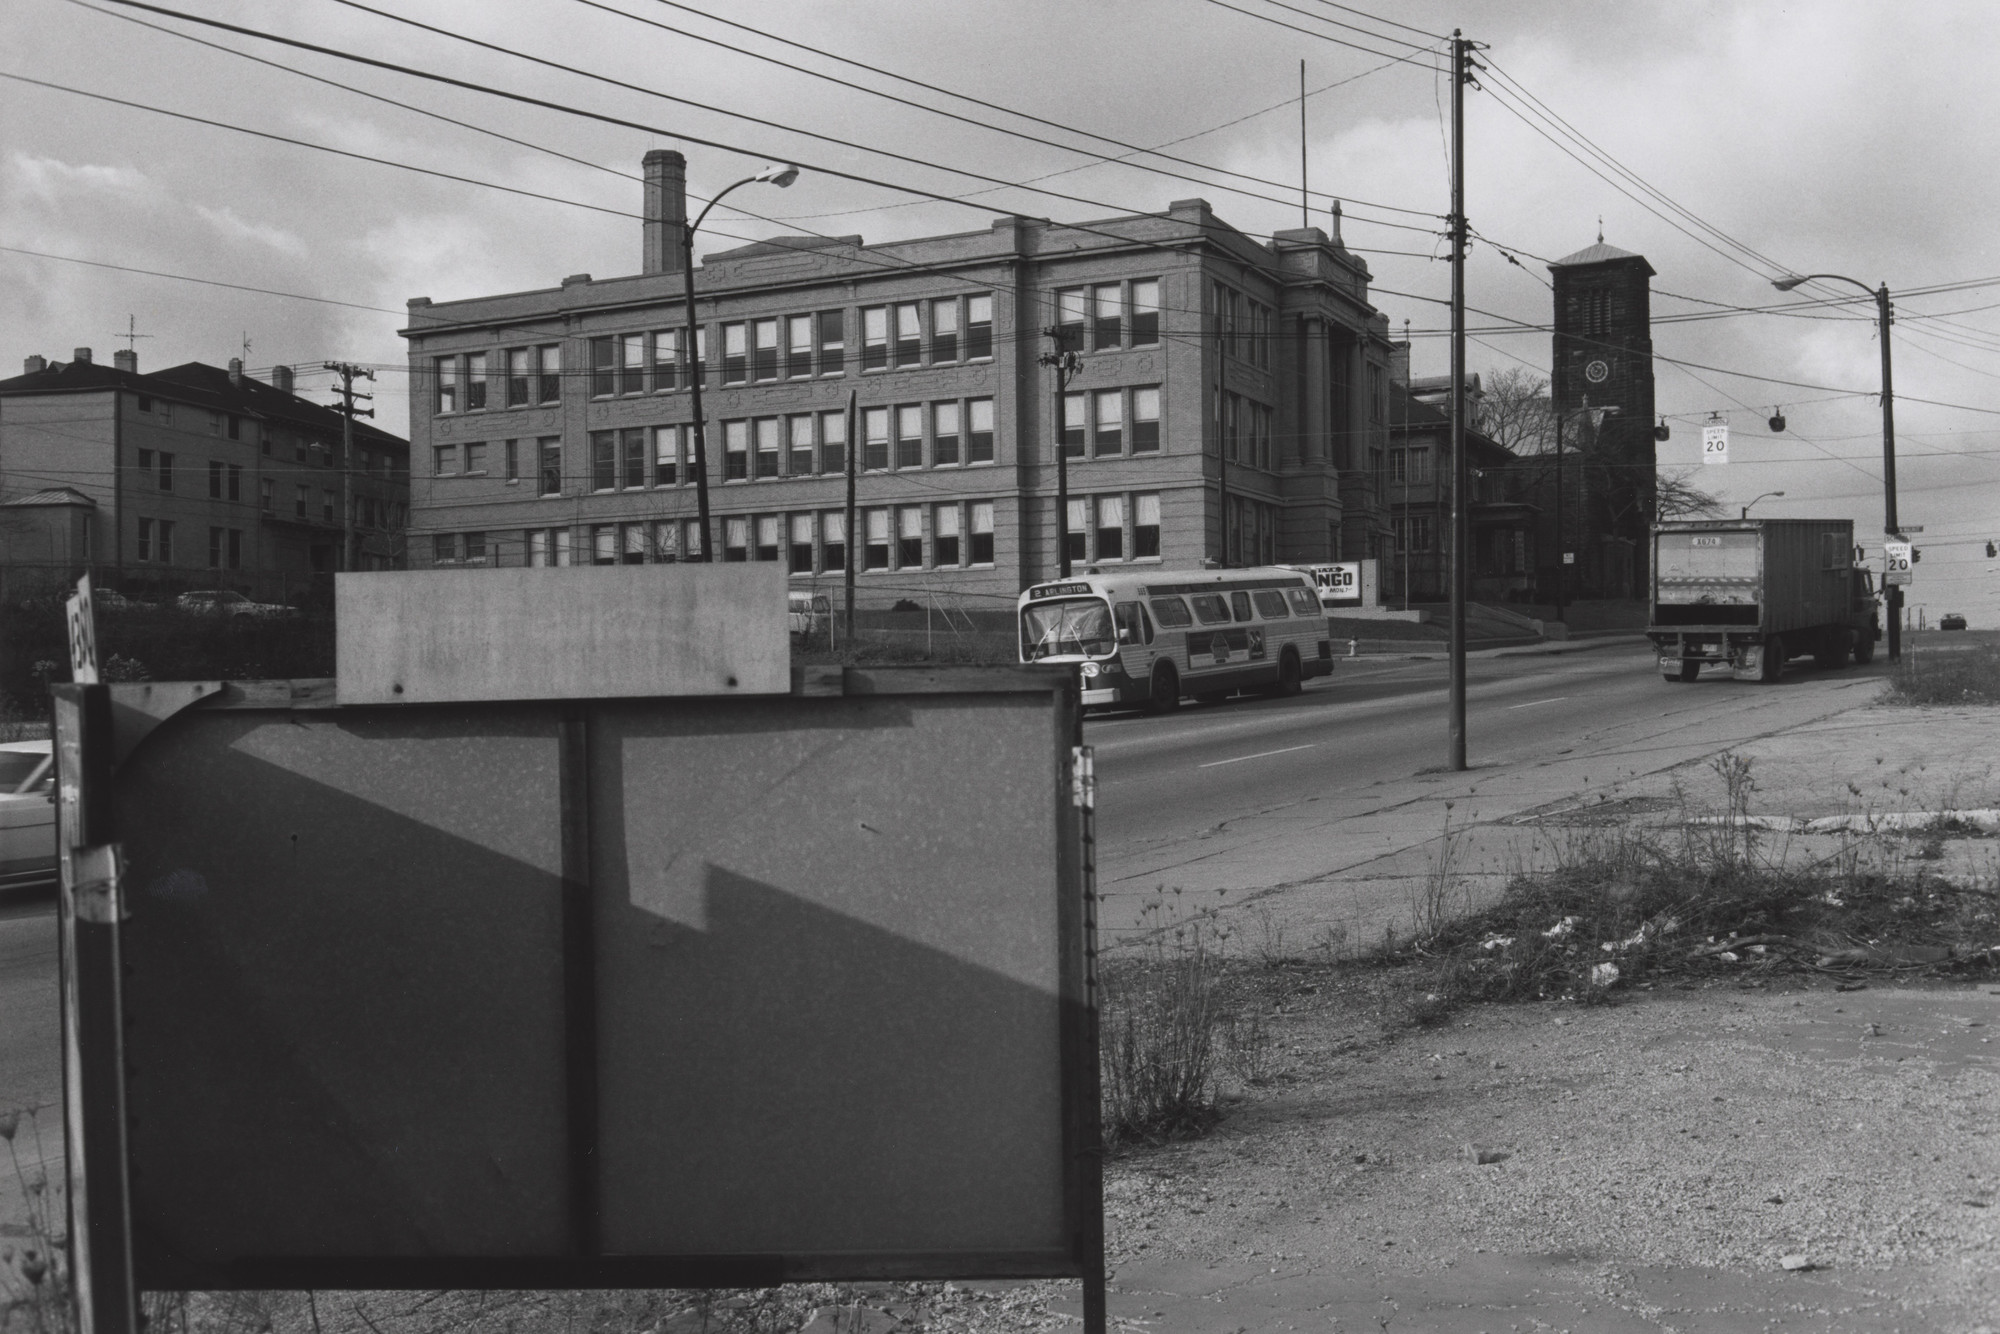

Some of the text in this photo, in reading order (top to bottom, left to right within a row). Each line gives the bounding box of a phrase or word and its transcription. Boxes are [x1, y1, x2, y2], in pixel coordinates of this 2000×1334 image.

[1707, 440, 1725, 452] 20
[1889, 558, 1908, 571] 20
[1034, 584, 1087, 598] 2 ARLINGTON
